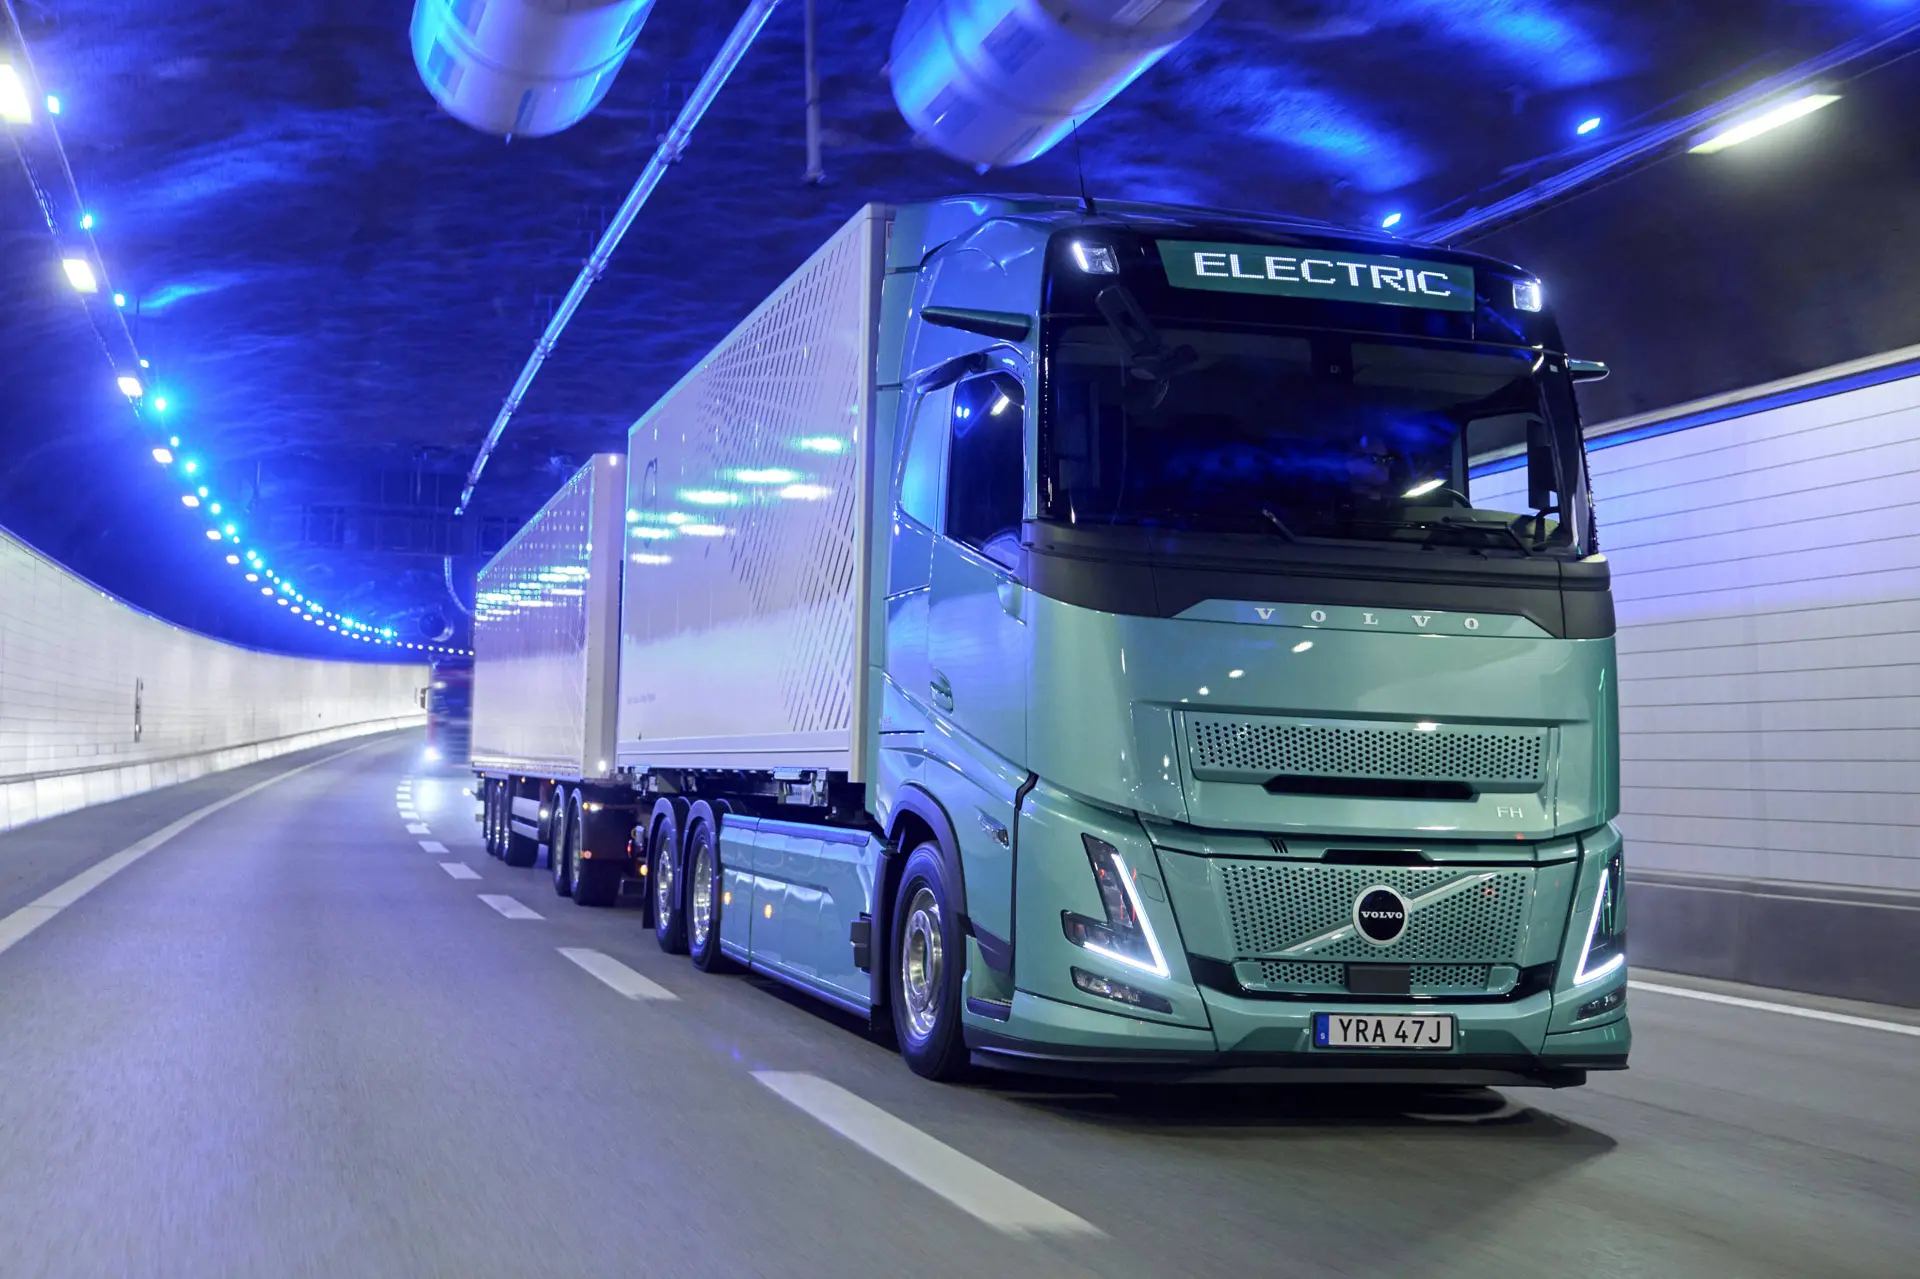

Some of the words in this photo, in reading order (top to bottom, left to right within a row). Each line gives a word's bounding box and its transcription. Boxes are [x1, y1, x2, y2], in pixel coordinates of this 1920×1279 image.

[1194, 252, 1451, 296] ELECTRIC
[1254, 607, 1480, 631] VOLVO
[1496, 805, 1524, 819] FH
[1361, 911, 1403, 919] VOLVO
[1320, 1032, 1326, 1040] S
[1338, 1018, 1386, 1043] YRA
[1394, 1020, 1441, 1044] 47J
